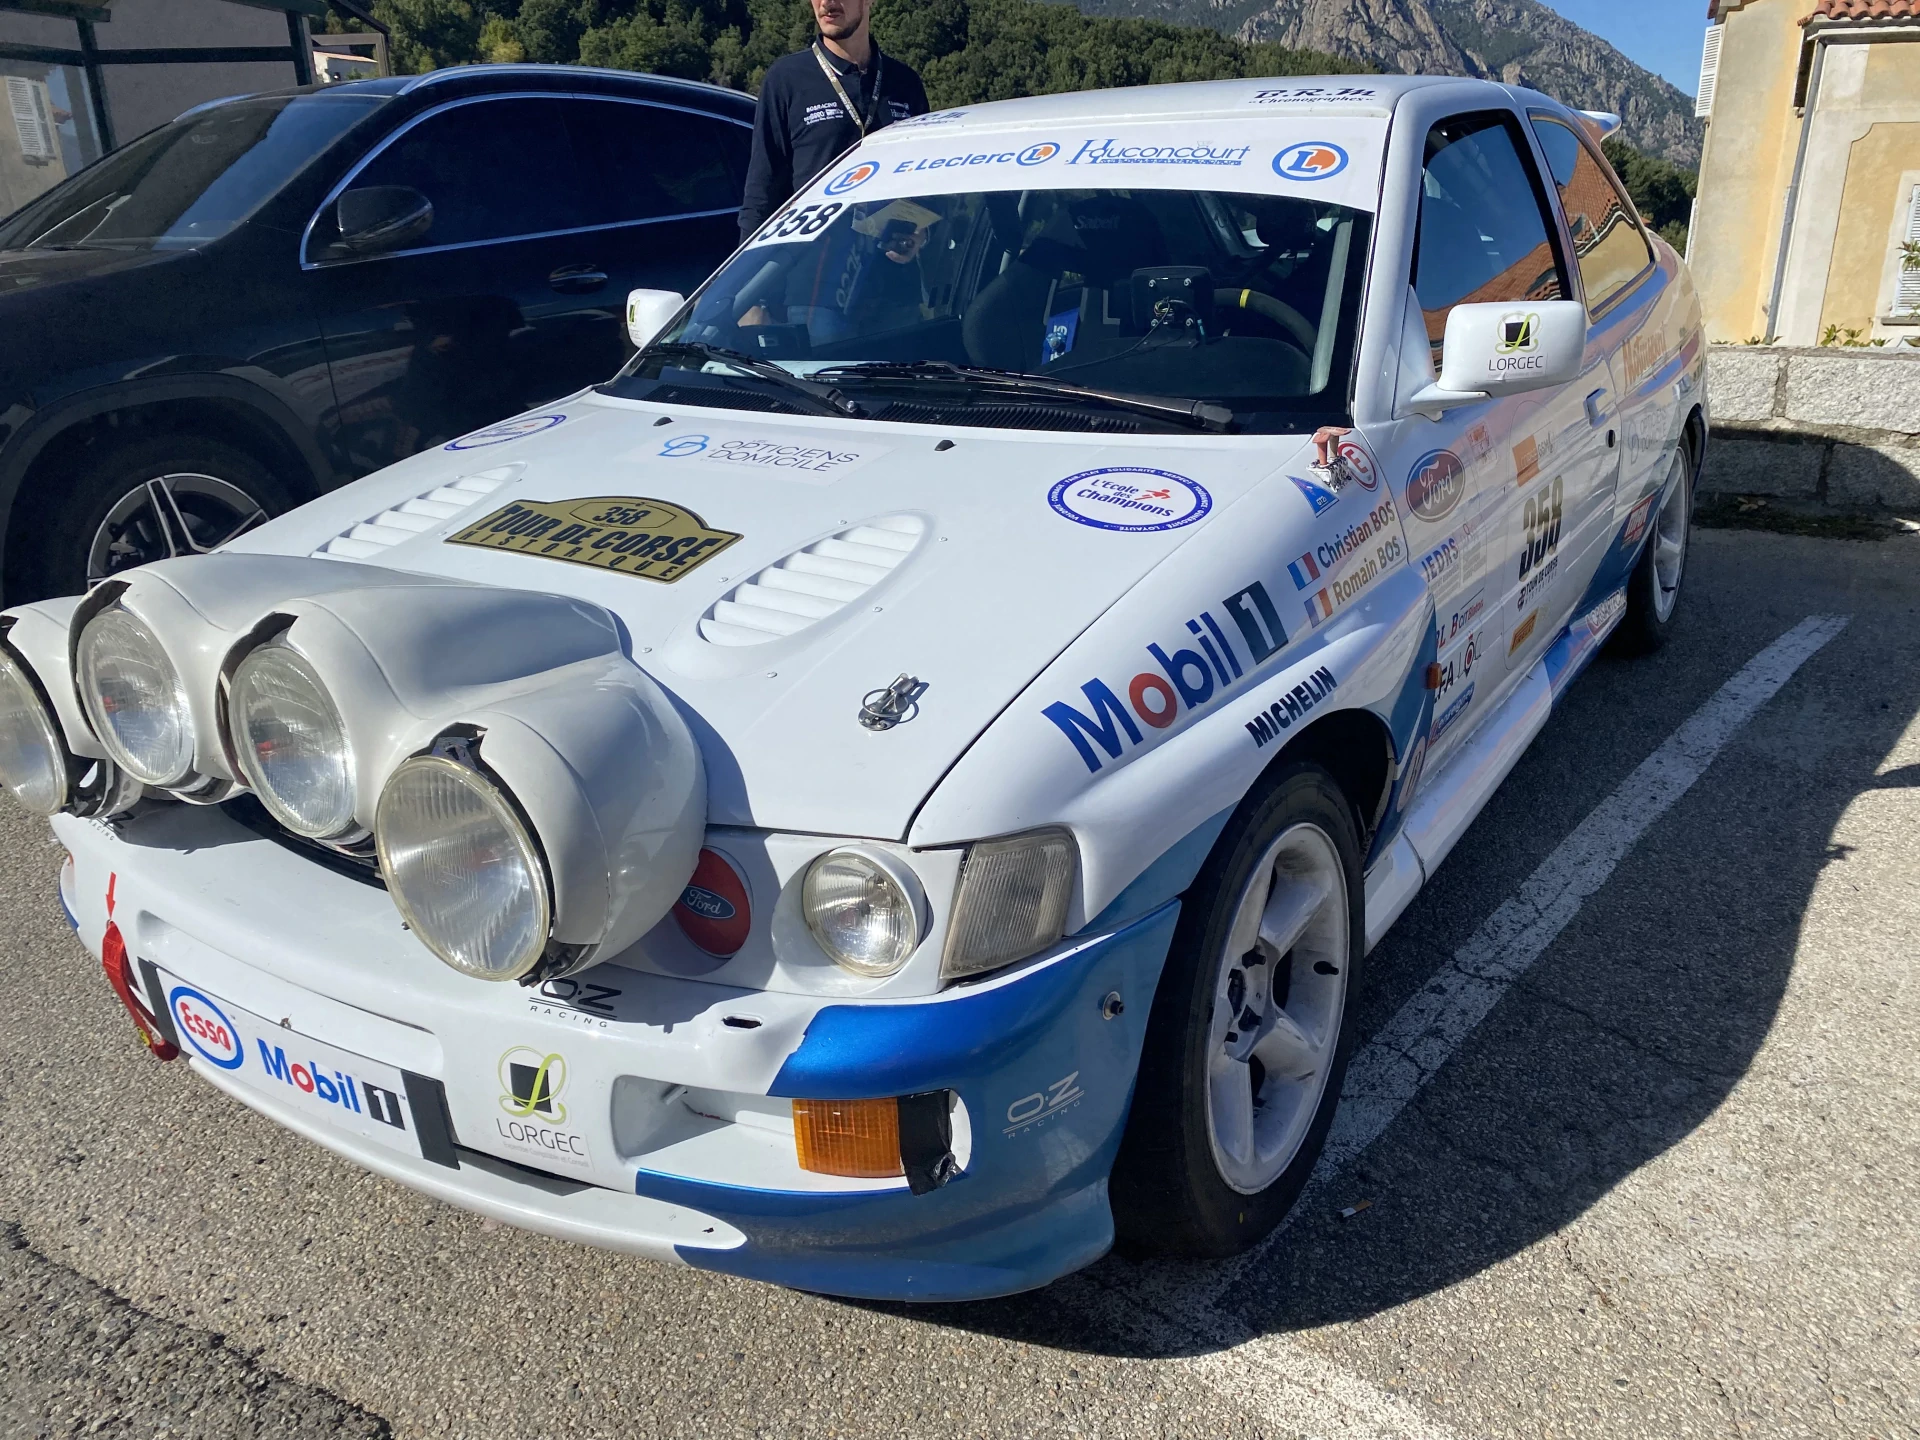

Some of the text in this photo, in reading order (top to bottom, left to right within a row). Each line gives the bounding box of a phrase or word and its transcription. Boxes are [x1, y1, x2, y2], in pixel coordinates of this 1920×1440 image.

[893, 152, 1016, 173] E.Leclerc
[757, 203, 844, 242] 358
[1488, 355, 1544, 371] LORGEC
[707, 449, 839, 472] DOMICILE
[721, 440, 861, 464] OPTICIENS
[1076, 489, 1174, 518] Champions
[1113, 491, 1132, 500] des
[1419, 460, 1455, 510] Ford
[594, 506, 652, 526] 358
[1317, 501, 1396, 569] Christian BOS
[1518, 475, 1564, 583] 358
[458, 530, 680, 577] HISTORIQUE
[475, 504, 721, 567] TOUR DE CORSE
[1332, 535, 1401, 606] Romain BOS
[1041, 611, 1244, 774] Mobil
[1244, 665, 1338, 749] MICHELIN
[687, 888, 721, 914] Ford
[530, 1005, 608, 1028] RACING
[256, 1037, 362, 1114] Mobil
[496, 1118, 584, 1156] LORGEC
[1008, 1101, 1081, 1139] RACING
